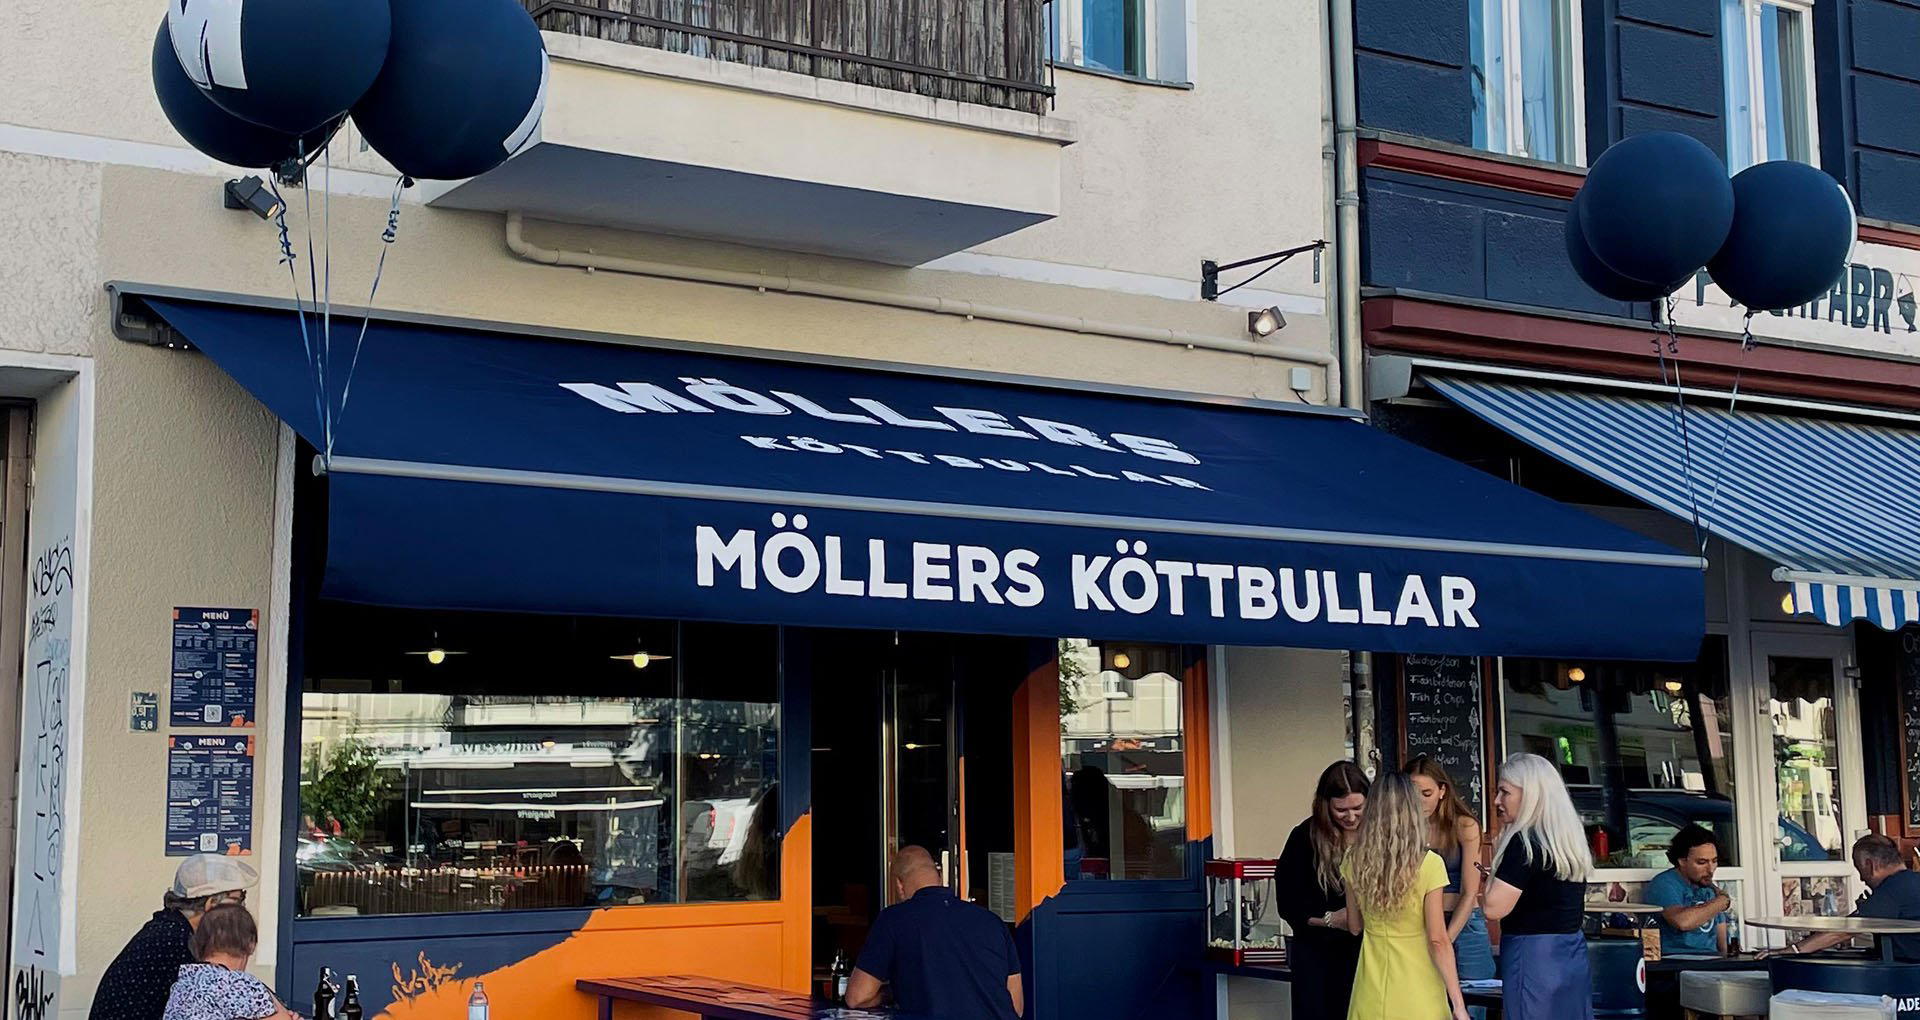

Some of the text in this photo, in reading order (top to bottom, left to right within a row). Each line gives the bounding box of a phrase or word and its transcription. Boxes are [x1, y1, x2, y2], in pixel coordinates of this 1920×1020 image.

[558, 375, 1202, 465] MÖLLERS
[740, 434, 1213, 491] KÖTTBULLAR
[695, 512, 1480, 629] MÖLLERS KÖTTBULLAR
[198, 738, 226, 746] MENU
